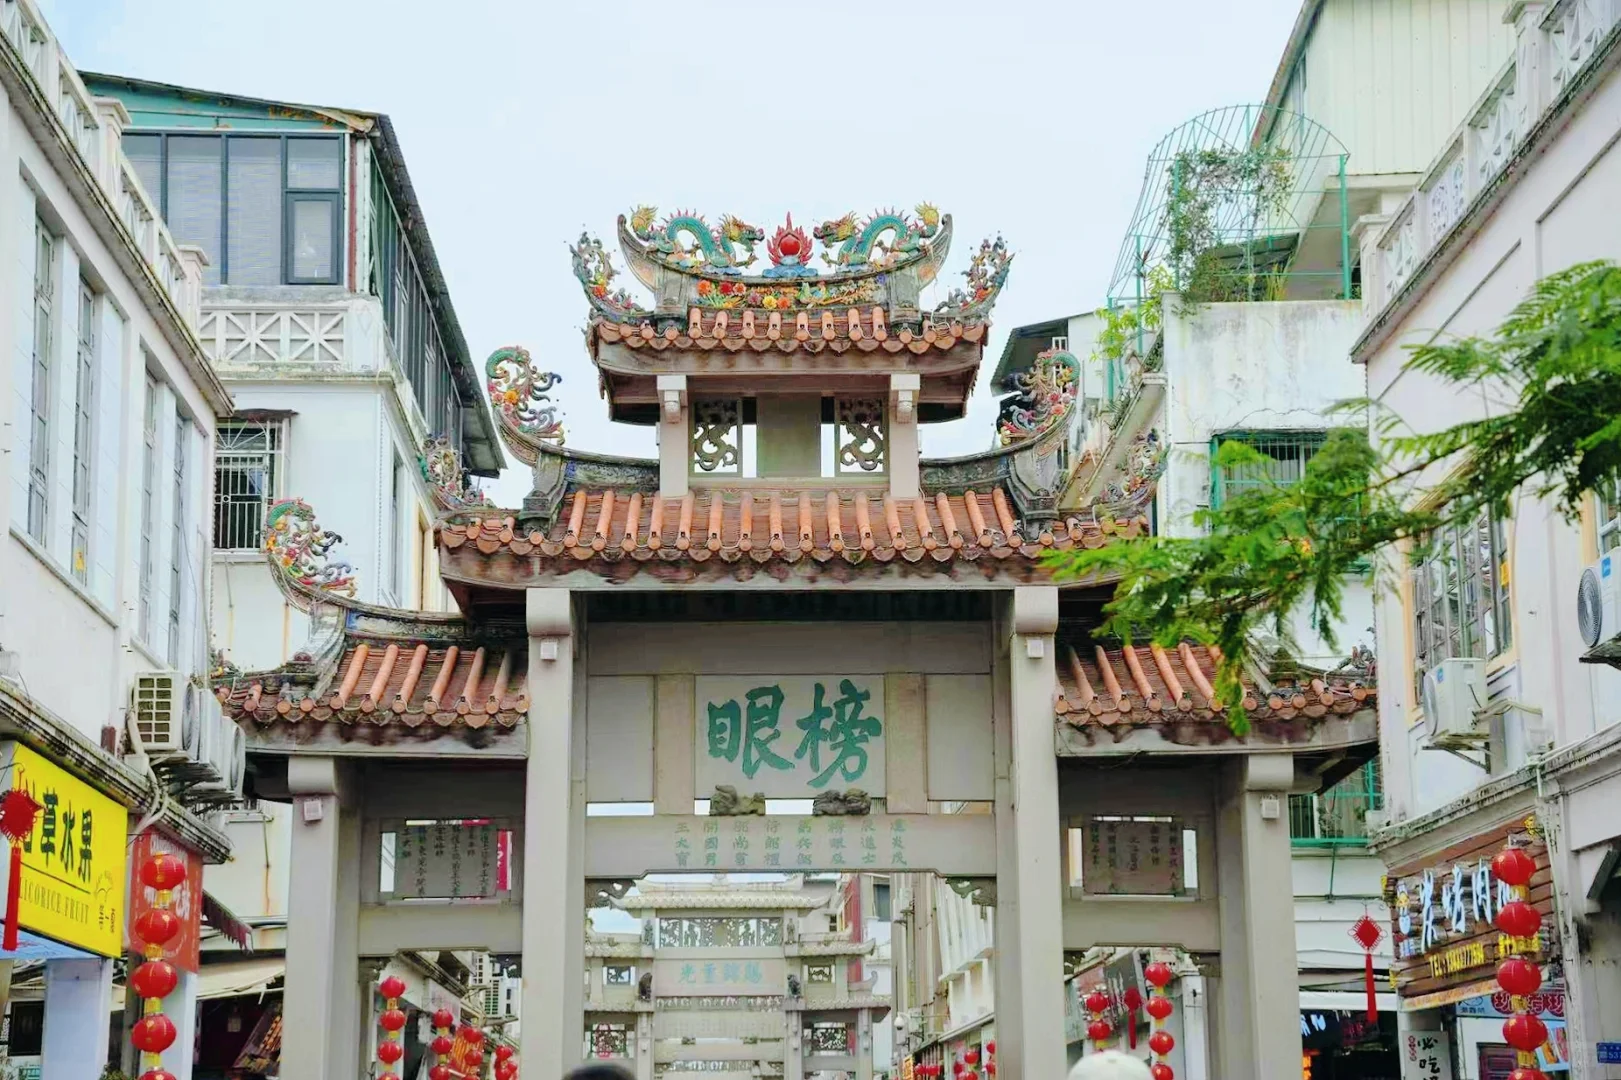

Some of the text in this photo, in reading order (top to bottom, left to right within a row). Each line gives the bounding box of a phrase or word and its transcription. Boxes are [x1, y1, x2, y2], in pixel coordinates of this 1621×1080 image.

[22, 778, 93, 884] 草水果
[65, 895, 90, 924] FRUIT
[1417, 1036, 1441, 1080] 必吃
